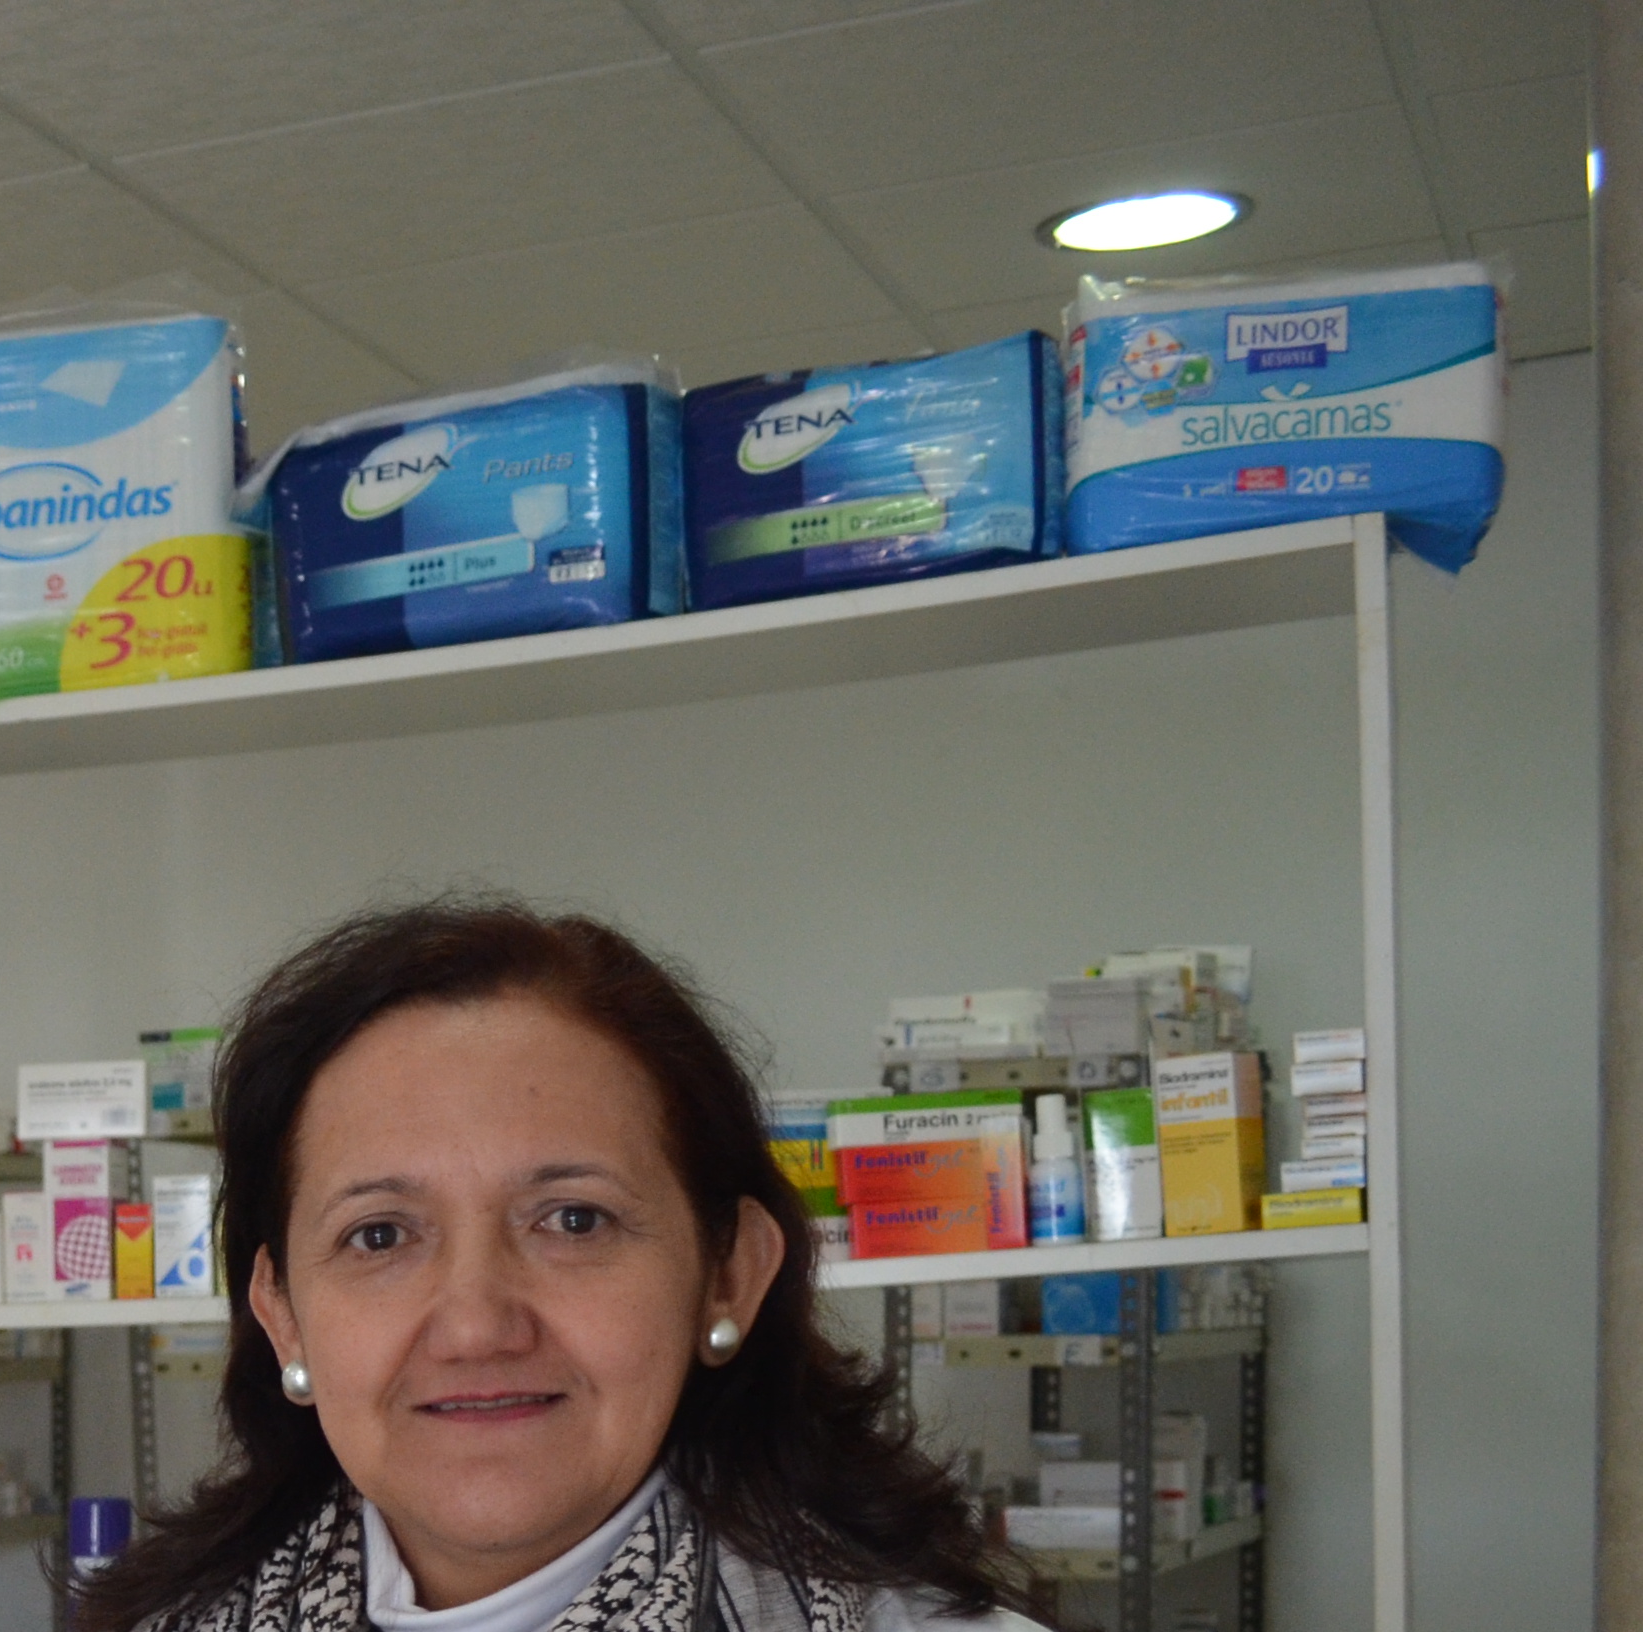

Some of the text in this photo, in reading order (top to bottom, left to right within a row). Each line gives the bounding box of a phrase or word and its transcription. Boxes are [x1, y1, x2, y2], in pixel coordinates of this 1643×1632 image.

[1235, 317, 1338, 346] LINDOR
[745, 409, 856, 438] TENA
[1181, 402, 1391, 446] salvacamas
[350, 453, 452, 485] TENA
[483, 452, 574, 483] Pants
[1296, 468, 1334, 493] 20
[464, 554, 496, 571] Plus
